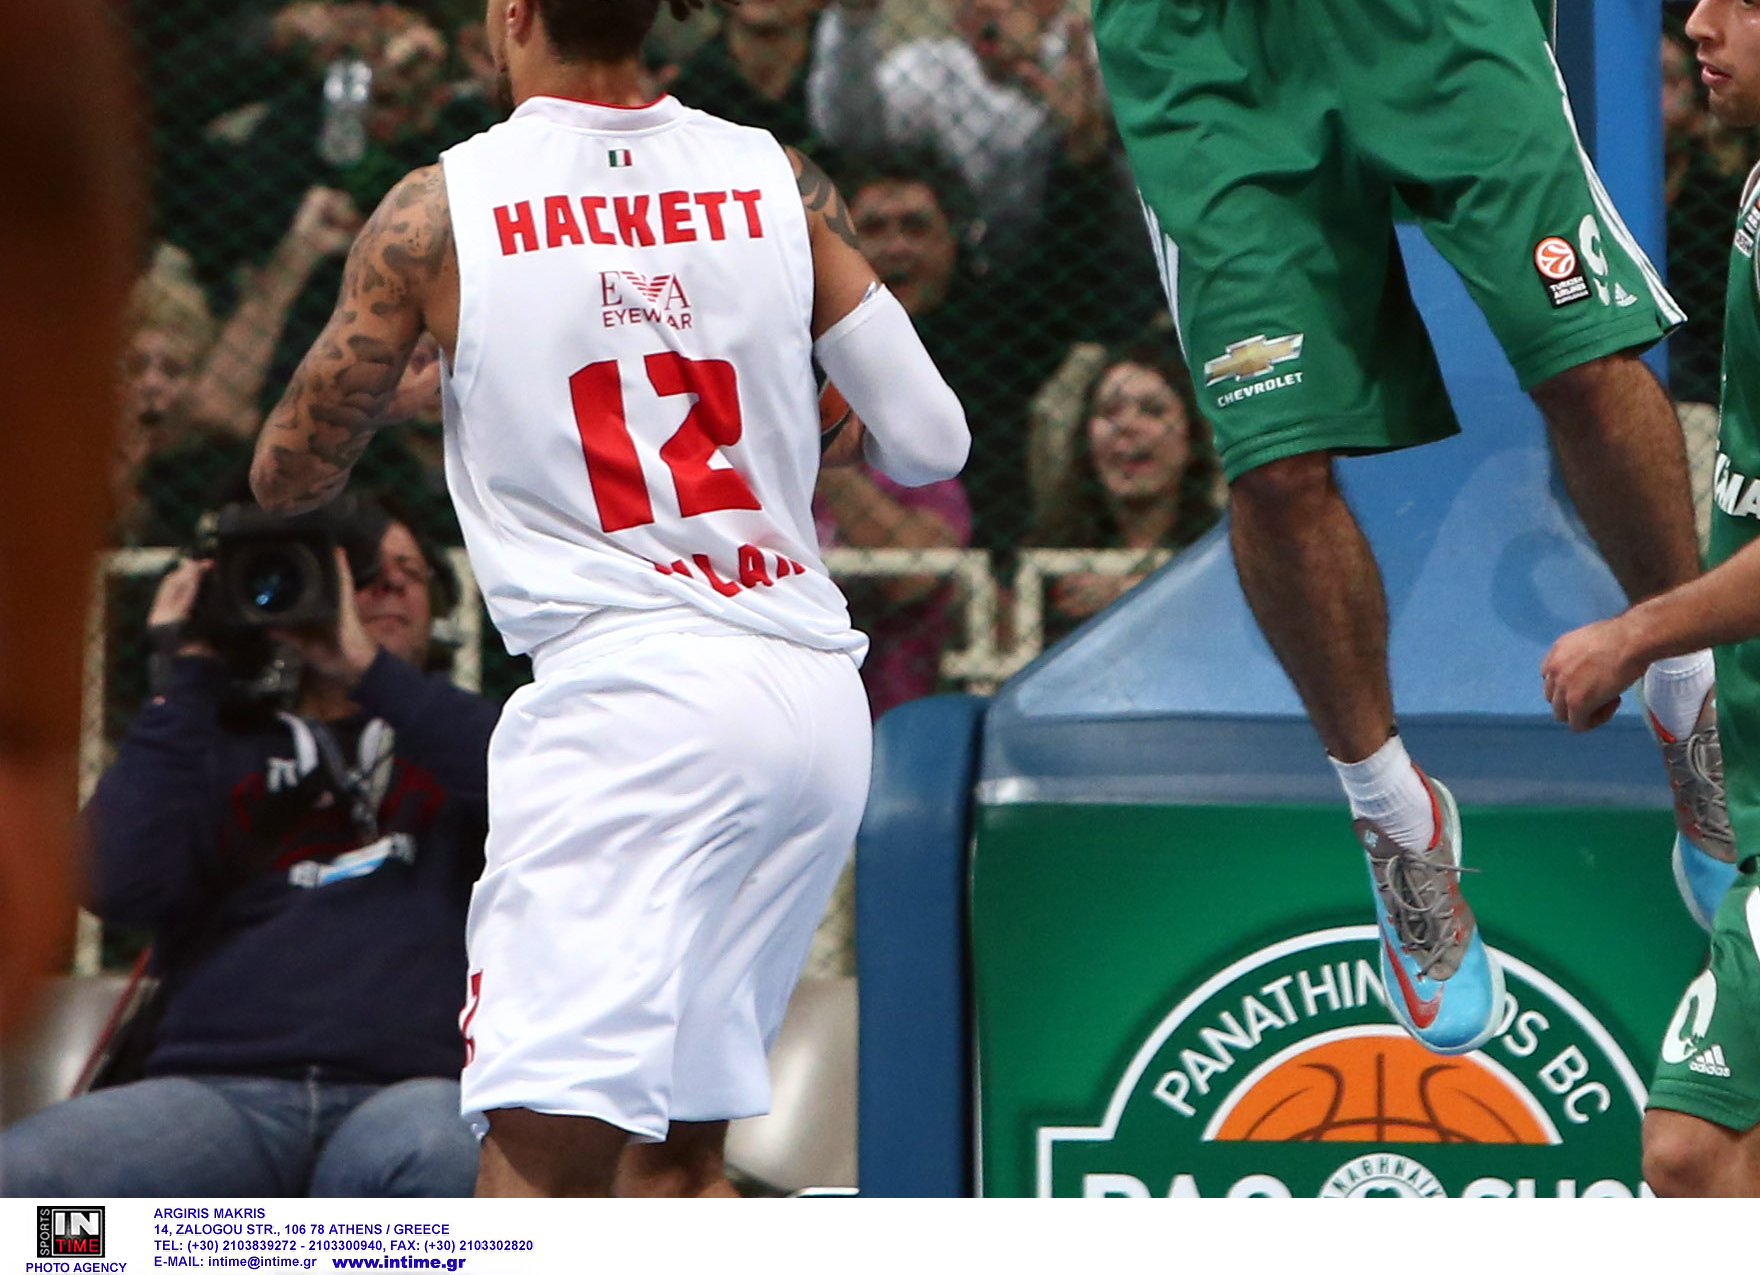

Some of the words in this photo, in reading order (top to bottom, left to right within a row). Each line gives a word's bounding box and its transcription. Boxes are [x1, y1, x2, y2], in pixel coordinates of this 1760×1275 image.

[494, 189, 763, 256] HACKETT
[602, 308, 692, 331] EYEWAR
[1217, 371, 1304, 408] CHEVROLET
[569, 350, 763, 534] 12
[1538, 1044, 1612, 1125] BC
[1689, 1060, 1731, 1078] adidas
